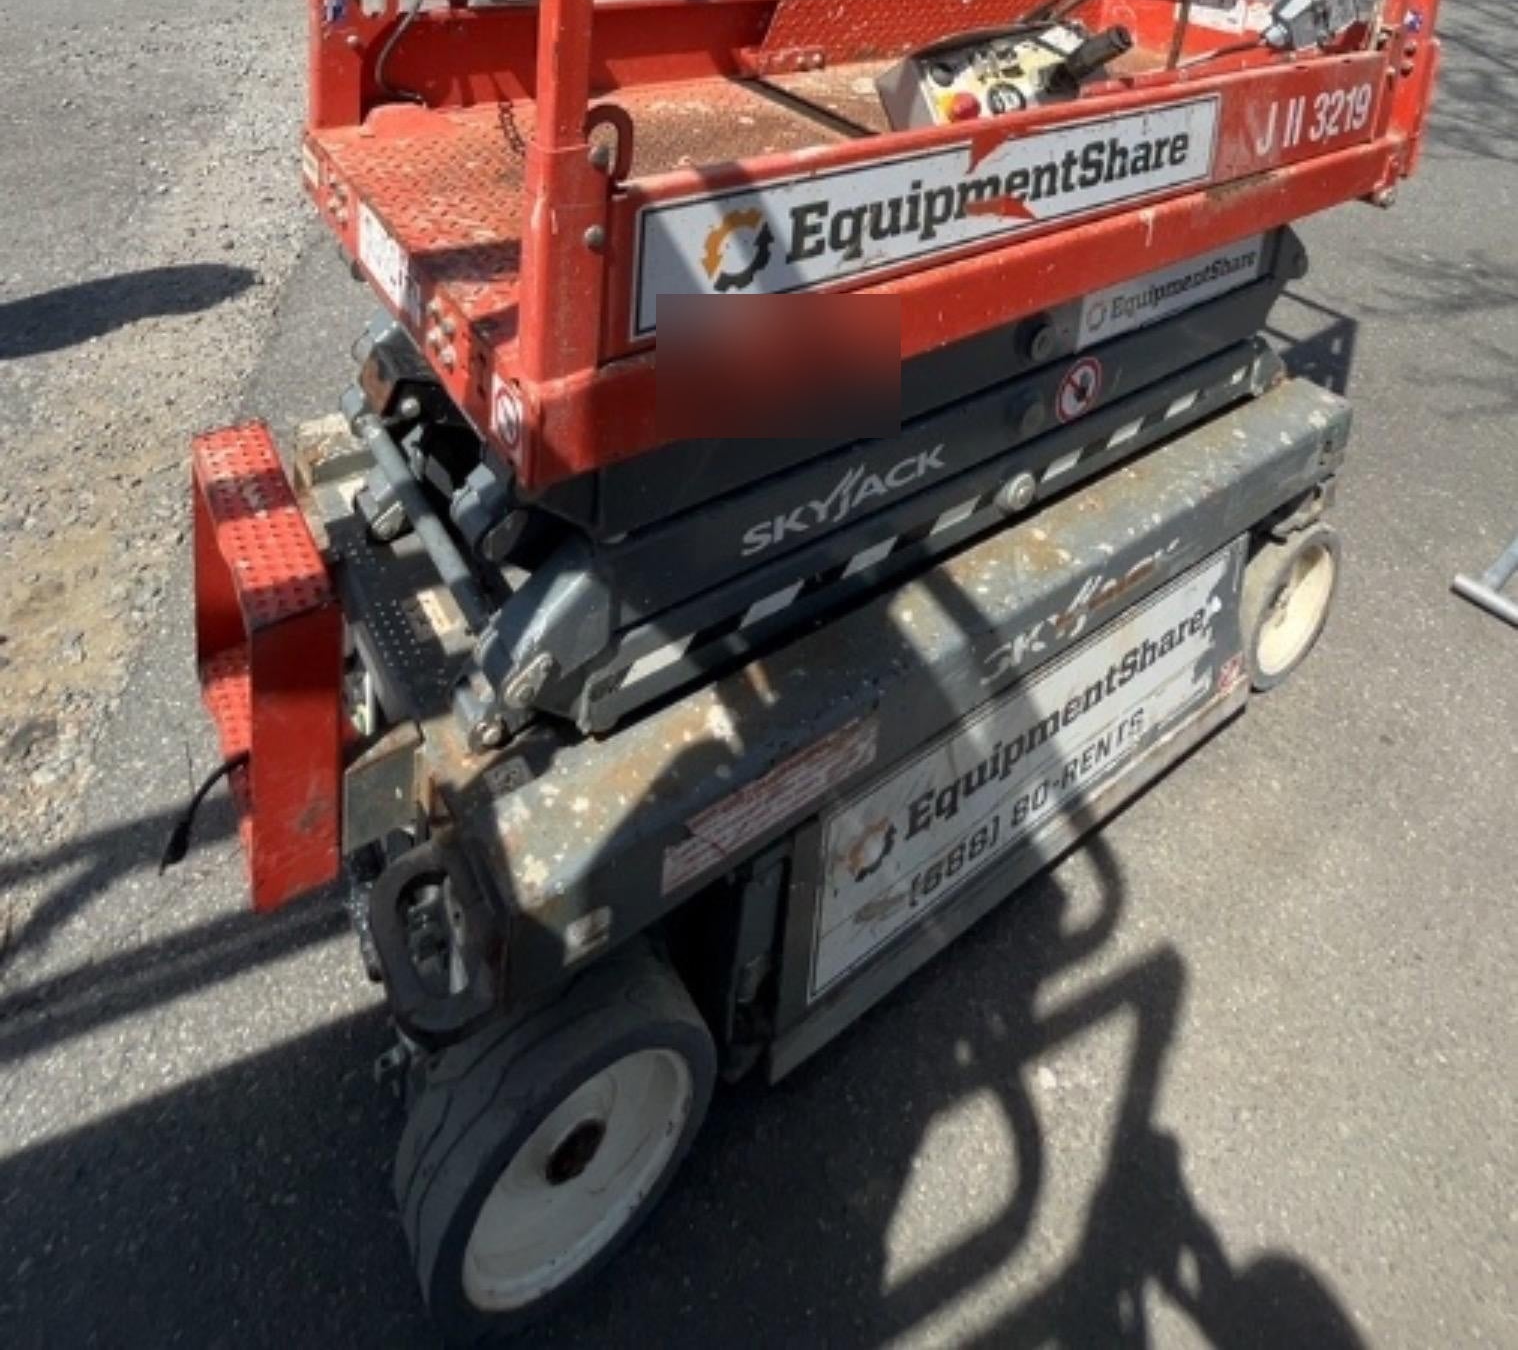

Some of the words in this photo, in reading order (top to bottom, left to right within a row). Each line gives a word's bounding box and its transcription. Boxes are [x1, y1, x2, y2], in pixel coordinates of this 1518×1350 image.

[1309, 83, 1372, 144] 3219
[786, 132, 1189, 264] EquipmentShare
[1111, 252, 1257, 319] EquipmentShare
[740, 443, 946, 557] SKYJACK
[904, 608, 1206, 840] EquipmentShare
